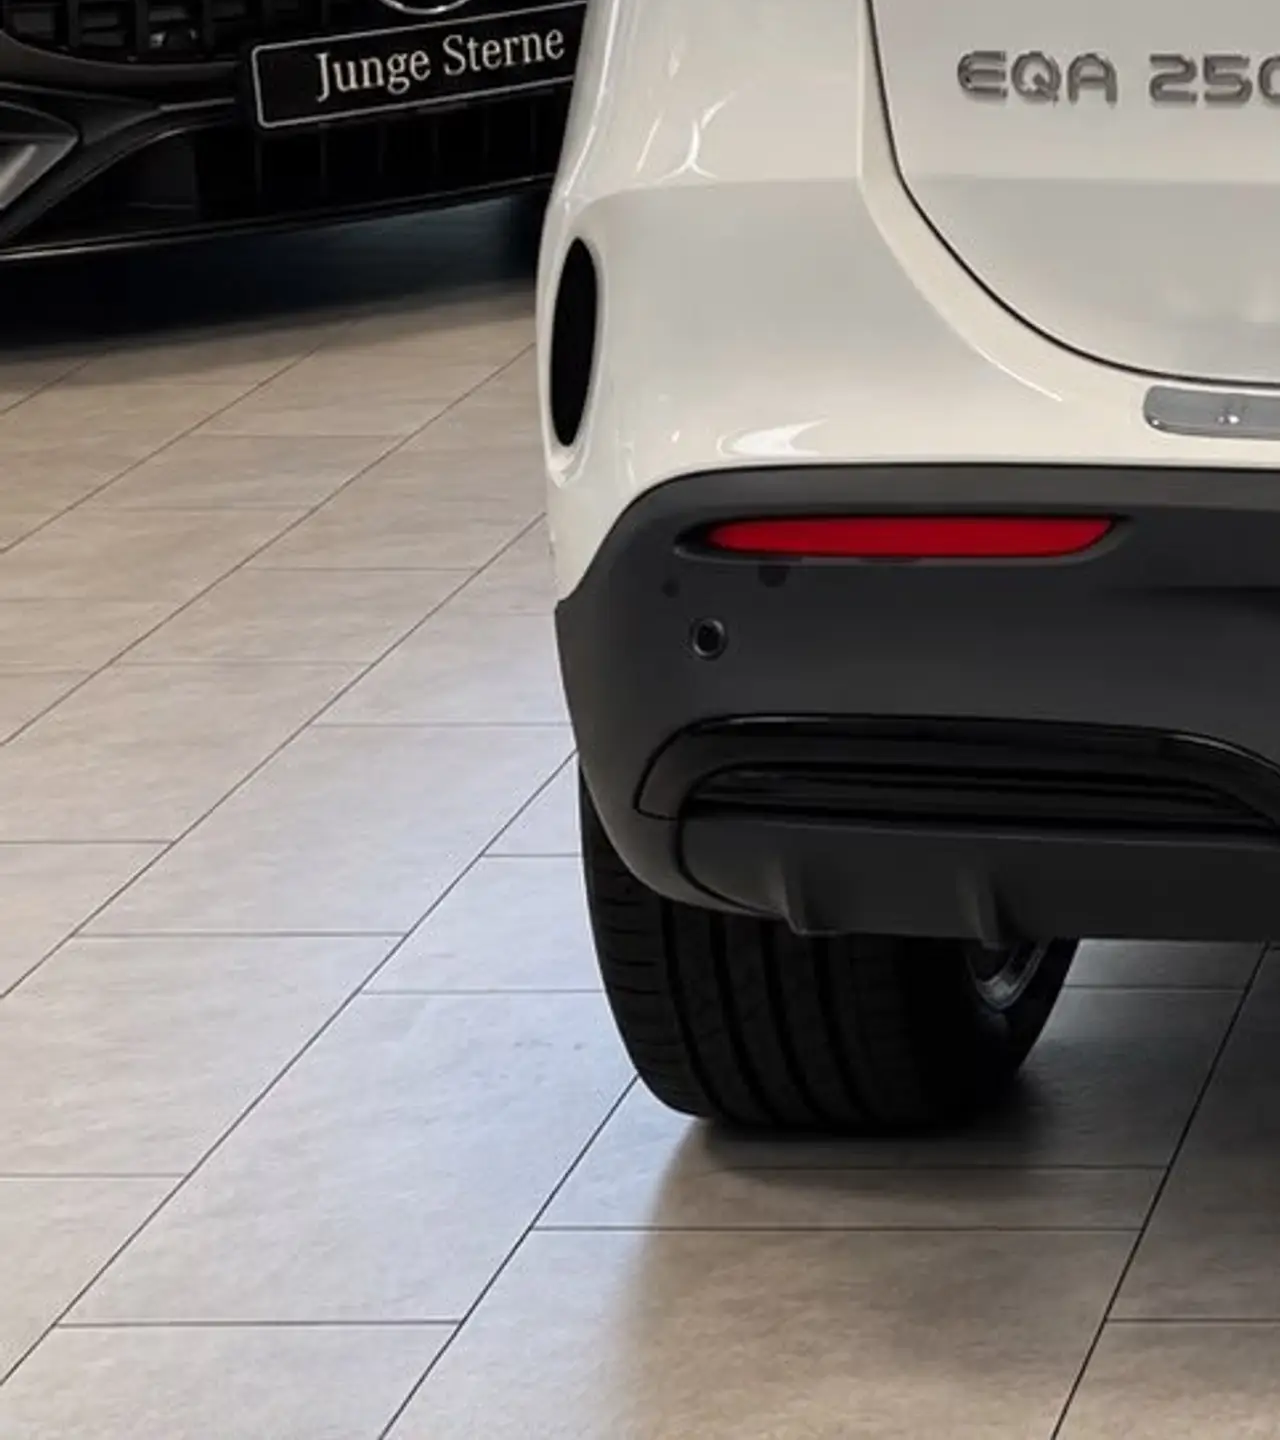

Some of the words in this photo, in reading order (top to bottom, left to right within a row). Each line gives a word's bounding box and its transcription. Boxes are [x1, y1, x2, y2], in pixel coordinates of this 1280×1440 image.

[314, 48, 432, 103] Junge
[442, 28, 566, 78] Sterne
[956, 49, 1120, 107] EQA
